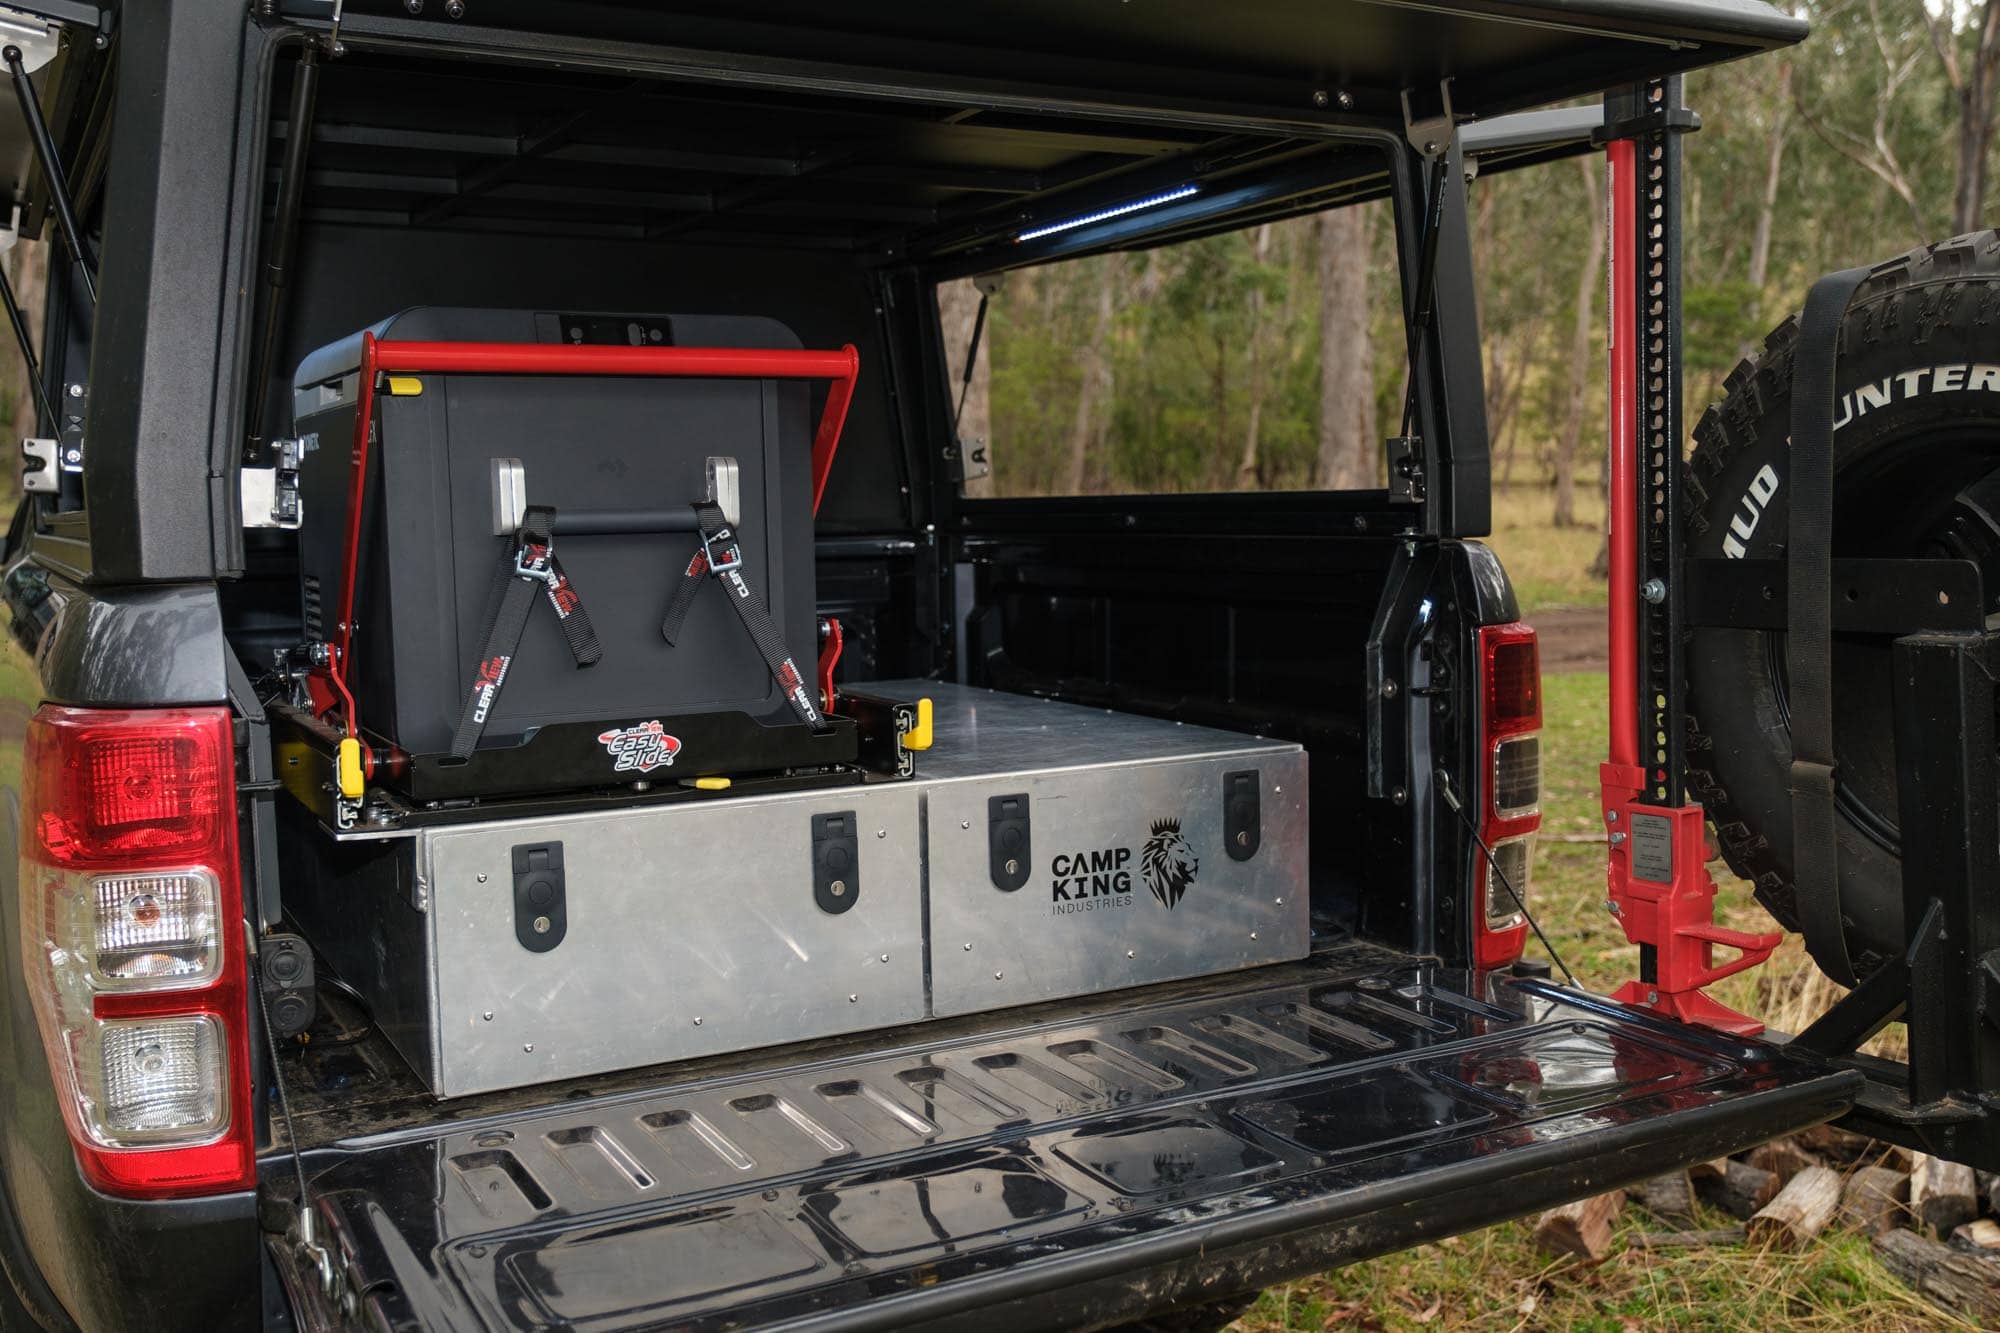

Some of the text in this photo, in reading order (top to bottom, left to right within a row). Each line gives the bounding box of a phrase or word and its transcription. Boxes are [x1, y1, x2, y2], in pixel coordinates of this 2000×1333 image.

[1833, 364, 2000, 432] UNTER
[617, 747, 671, 769] Slide
[1053, 848, 1130, 877] CAMP
[1052, 871, 1131, 902] KING
[1052, 895, 1132, 915] INDUSTRIES
